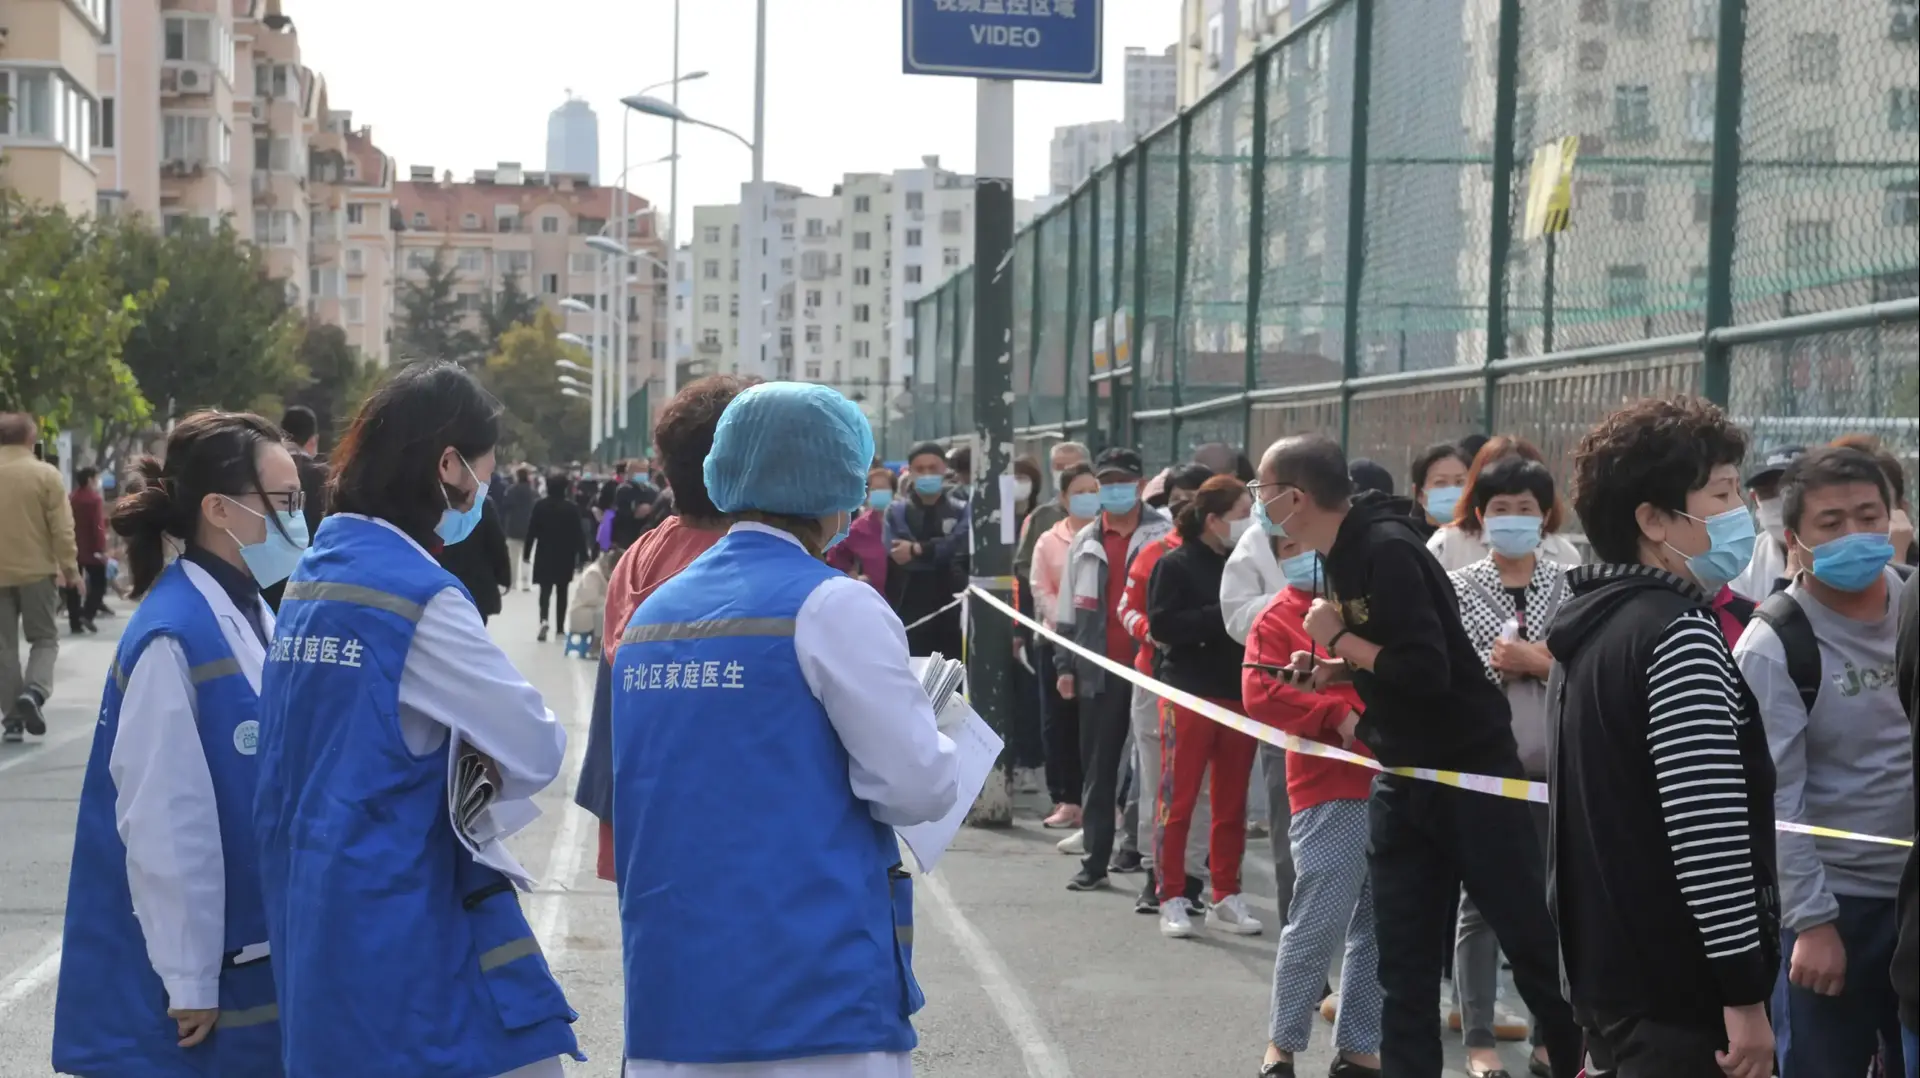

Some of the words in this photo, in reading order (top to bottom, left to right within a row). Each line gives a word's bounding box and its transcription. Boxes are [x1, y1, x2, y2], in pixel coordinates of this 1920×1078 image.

[970, 24, 1040, 47] VIDEO
[623, 660, 744, 692] 市北区家庭医生
